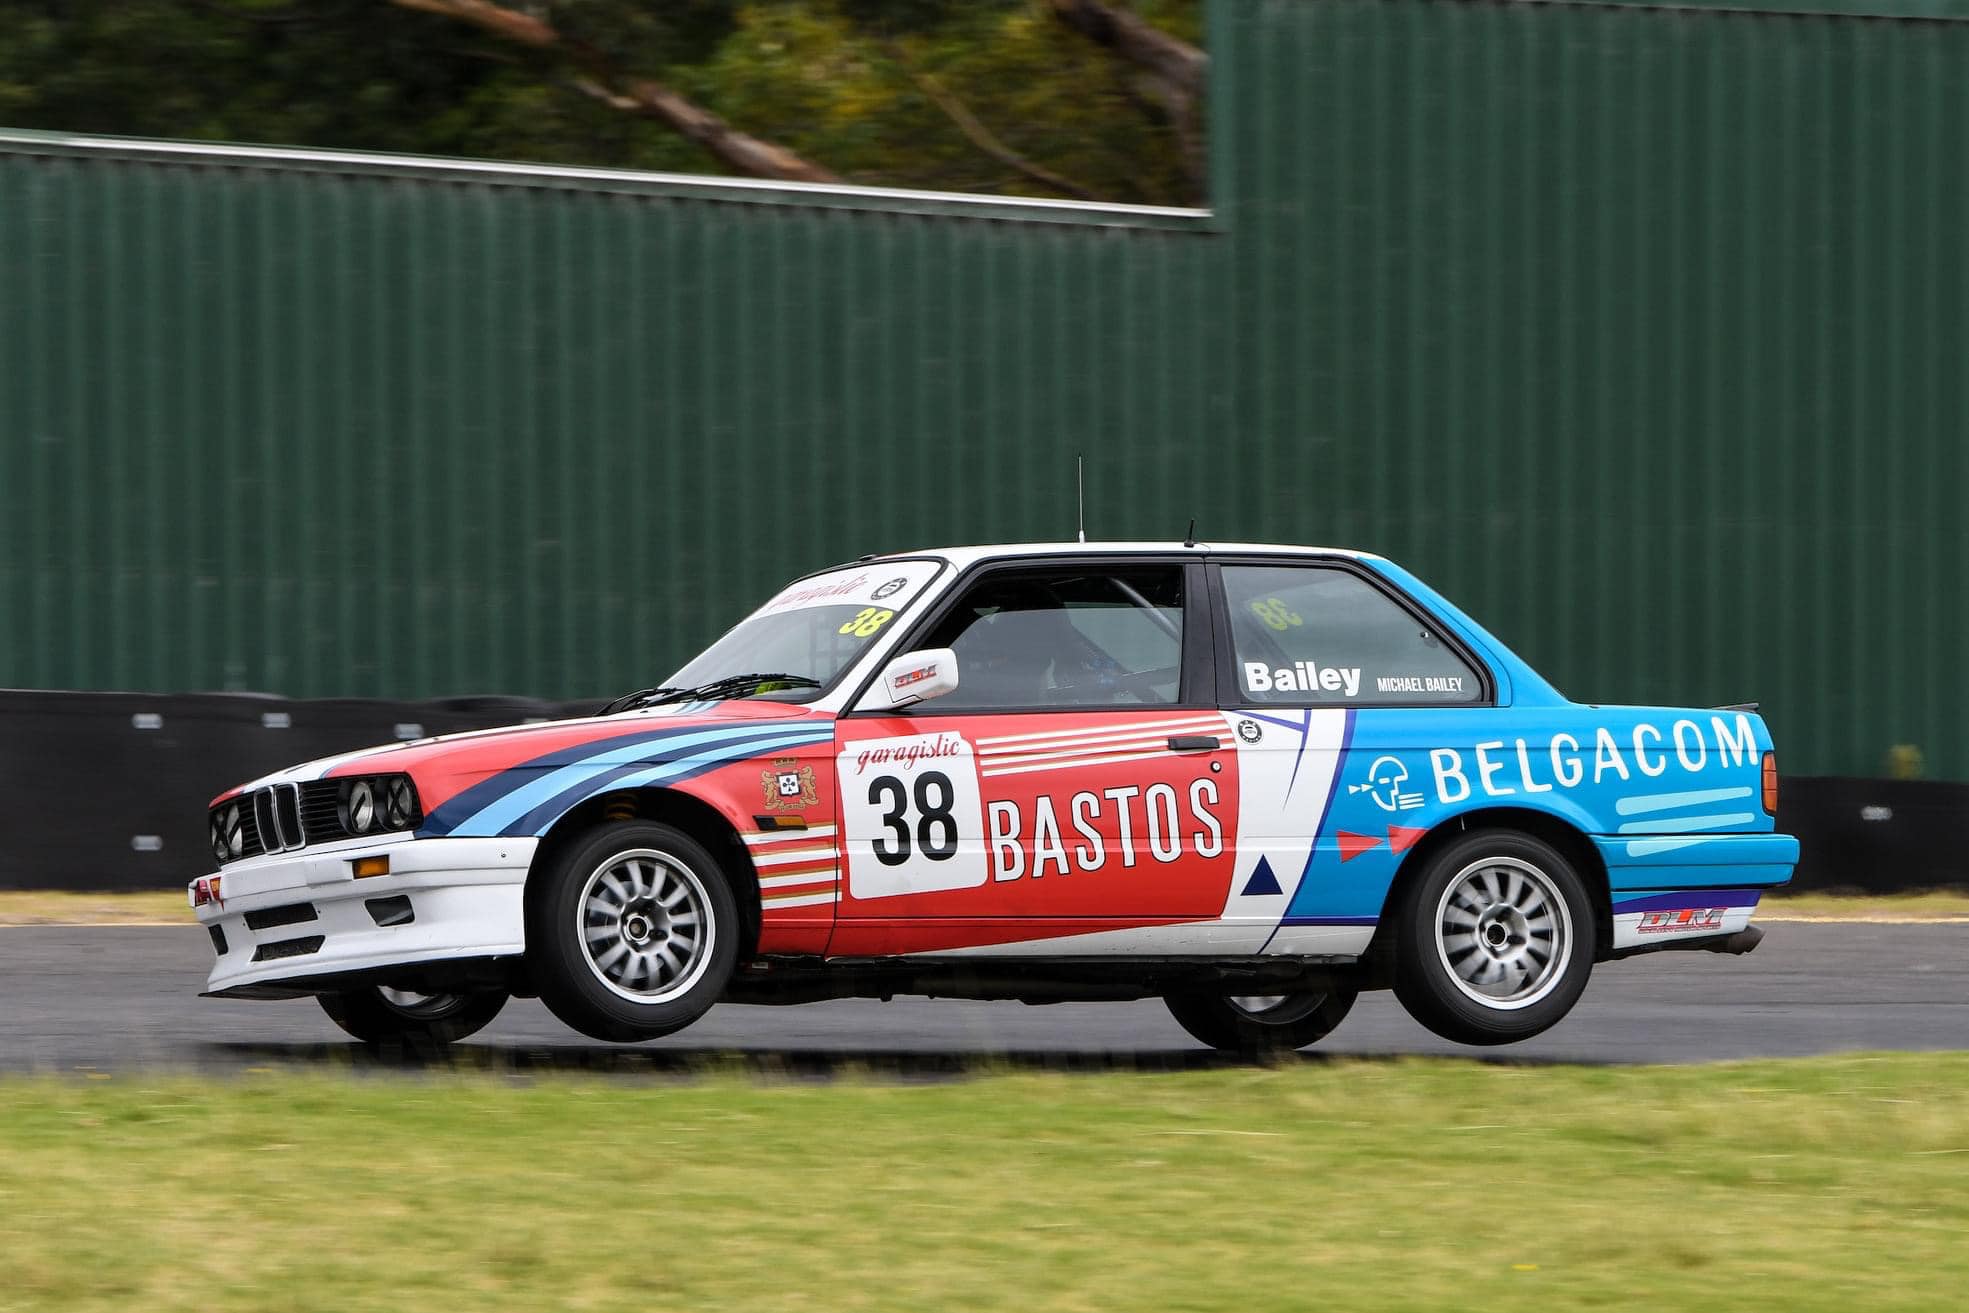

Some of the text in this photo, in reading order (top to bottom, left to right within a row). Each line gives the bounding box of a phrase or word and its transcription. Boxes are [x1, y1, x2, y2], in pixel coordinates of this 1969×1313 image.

[838, 607, 894, 637] 38
[1244, 661, 1361, 697] Bailey
[1376, 677, 1463, 692] MICHAEL BAILEY
[856, 734, 960, 775] garagistic
[1430, 714, 1759, 804] BELGACOM
[868, 771, 959, 866] 38
[987, 778, 1224, 882] BASTOS
[1636, 907, 1728, 929] DLM
